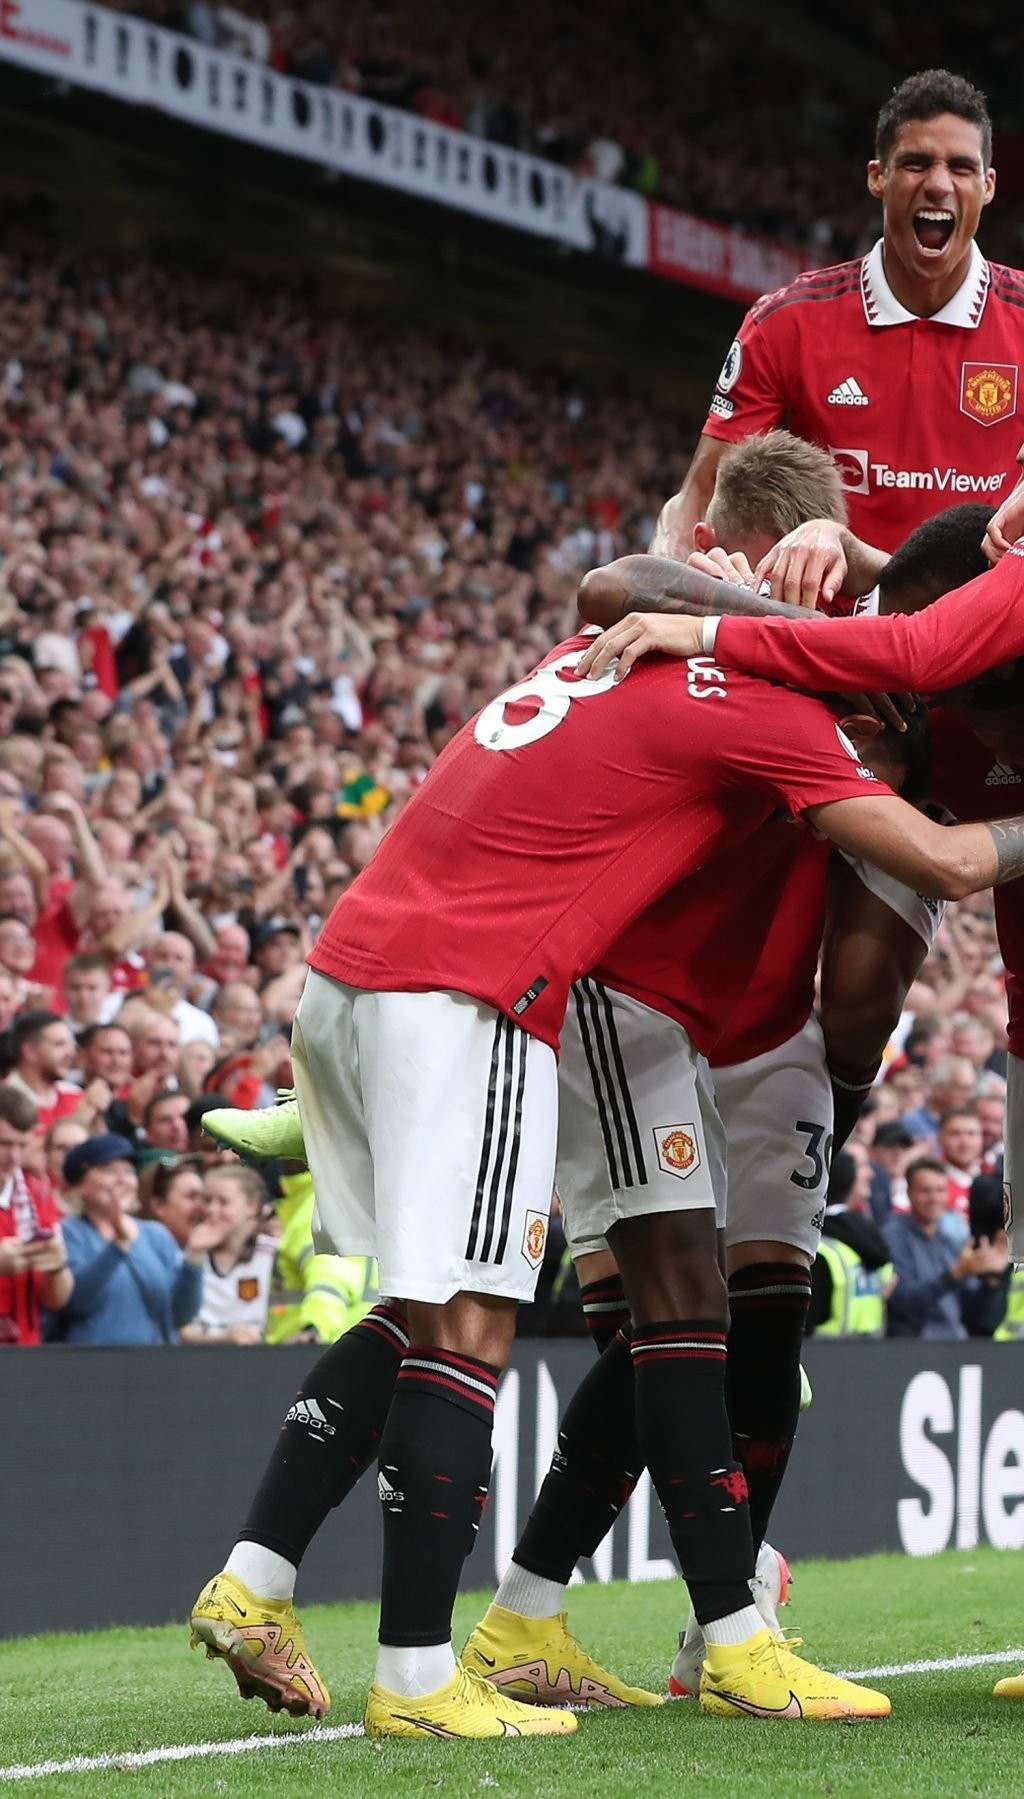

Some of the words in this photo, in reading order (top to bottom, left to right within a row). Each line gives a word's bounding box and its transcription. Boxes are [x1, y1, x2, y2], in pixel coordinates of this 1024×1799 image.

[827, 393, 869, 406] adidas
[871, 464, 1006, 493] TeamViewer
[474, 649, 631, 751] 8
[985, 773, 1022, 786] adidas
